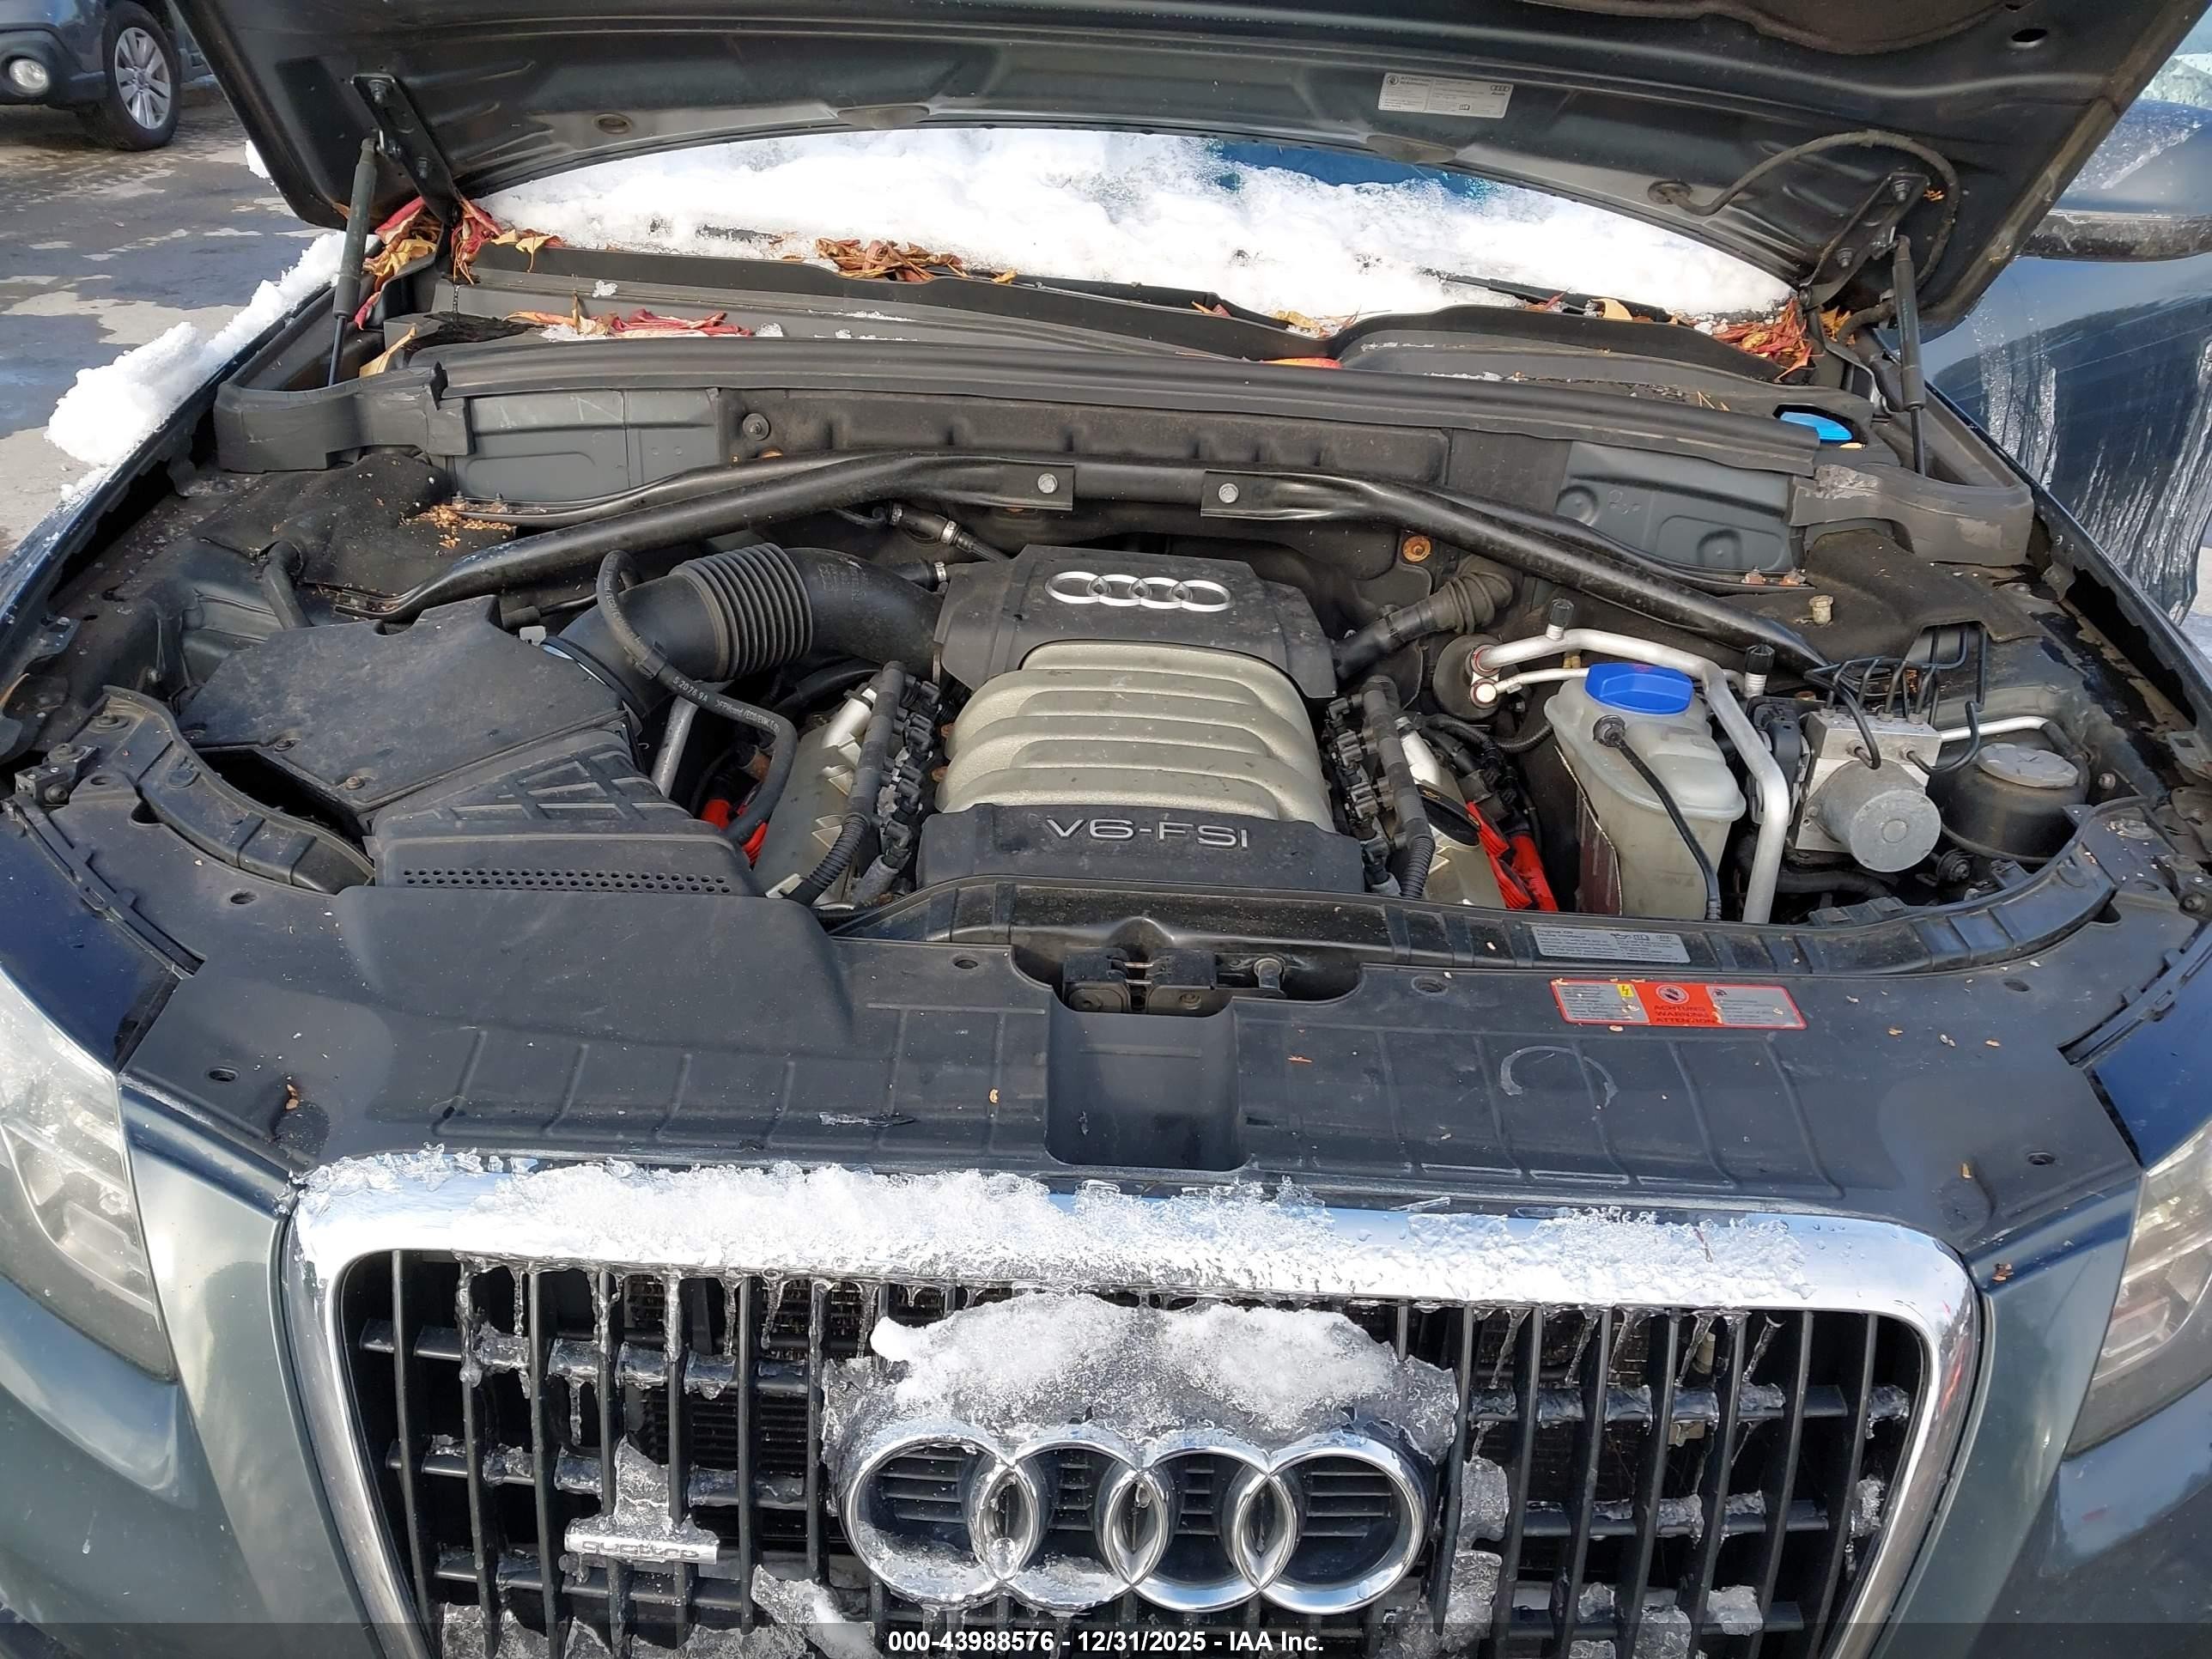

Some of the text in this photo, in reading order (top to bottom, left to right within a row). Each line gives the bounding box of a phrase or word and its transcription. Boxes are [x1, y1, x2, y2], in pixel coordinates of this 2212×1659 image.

[673, 676, 708, 702] S 2076 9A
[1046, 817, 1248, 848] V6-FSI
